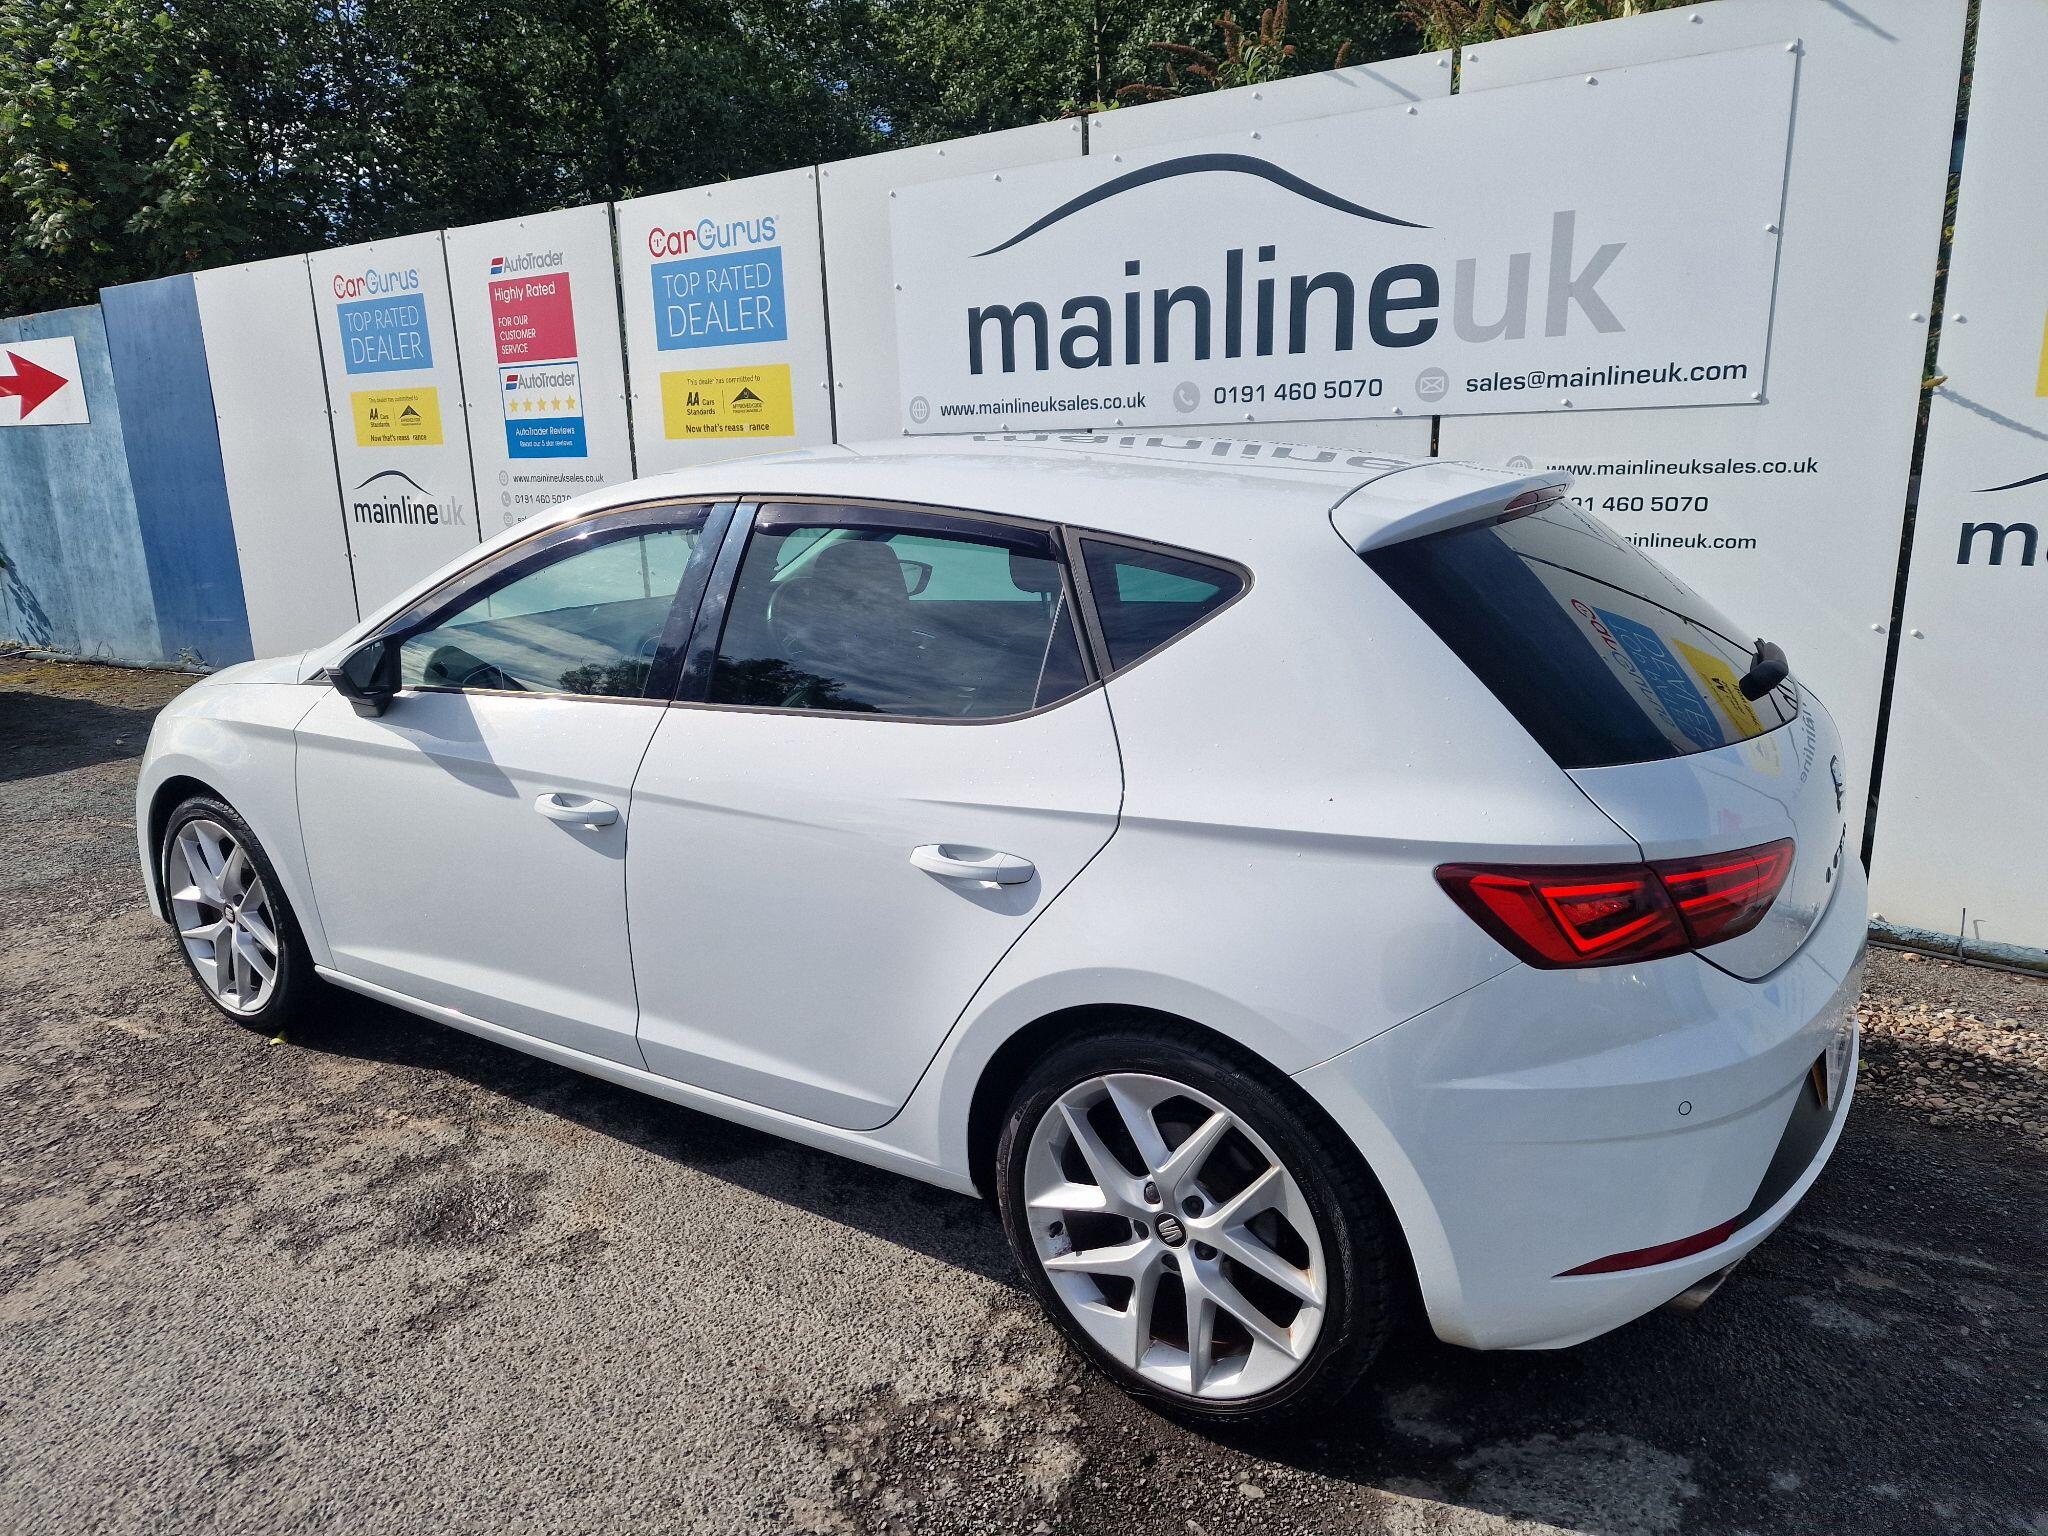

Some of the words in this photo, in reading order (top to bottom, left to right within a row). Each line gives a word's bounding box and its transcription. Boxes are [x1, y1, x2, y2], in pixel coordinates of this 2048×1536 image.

[648, 216, 776, 258] CarGurus
[504, 250, 564, 273] AutoTrader
[333, 268, 419, 299] CarGurus
[662, 271, 700, 299] TOP
[706, 262, 771, 293] RATED
[494, 285, 524, 303] Highly
[526, 281, 556, 298] Rated
[967, 210, 1627, 376] mainlineuk
[345, 311, 371, 332] TOP
[374, 305, 419, 329] RATED
[498, 316, 512, 327] FOR
[513, 314, 528, 326] OUR
[667, 295, 774, 337] DEALER
[499, 328, 536, 341] CUSTOMER
[350, 331, 424, 364] DEALER
[501, 342, 528, 355] SERVICE
[518, 371, 575, 389] AutoTrader
[1465, 361, 1749, 393] sales@mainlineuk.com
[686, 392, 700, 406] AA
[702, 398, 715, 406] Cars
[1213, 384, 1266, 404] 0191
[1273, 382, 1317, 402] 460
[1323, 378, 1384, 400] 5070
[369, 408, 379, 420] AA
[686, 407, 715, 415] Standards
[940, 391, 1147, 418] www.mainlineuksales.co.uk
[515, 427, 548, 436] AutoTrader
[549, 426, 575, 435] Reviews
[685, 424, 702, 433] Now
[703, 423, 723, 432] that's
[513, 473, 604, 483] www.mainlineuksales.co.uk
[515, 494, 533, 504] 0191
[535, 494, 550, 504] 460
[1602, 496, 1644, 512] 460
[1650, 496, 1709, 512] 5070
[353, 496, 466, 526] mainlineuk
